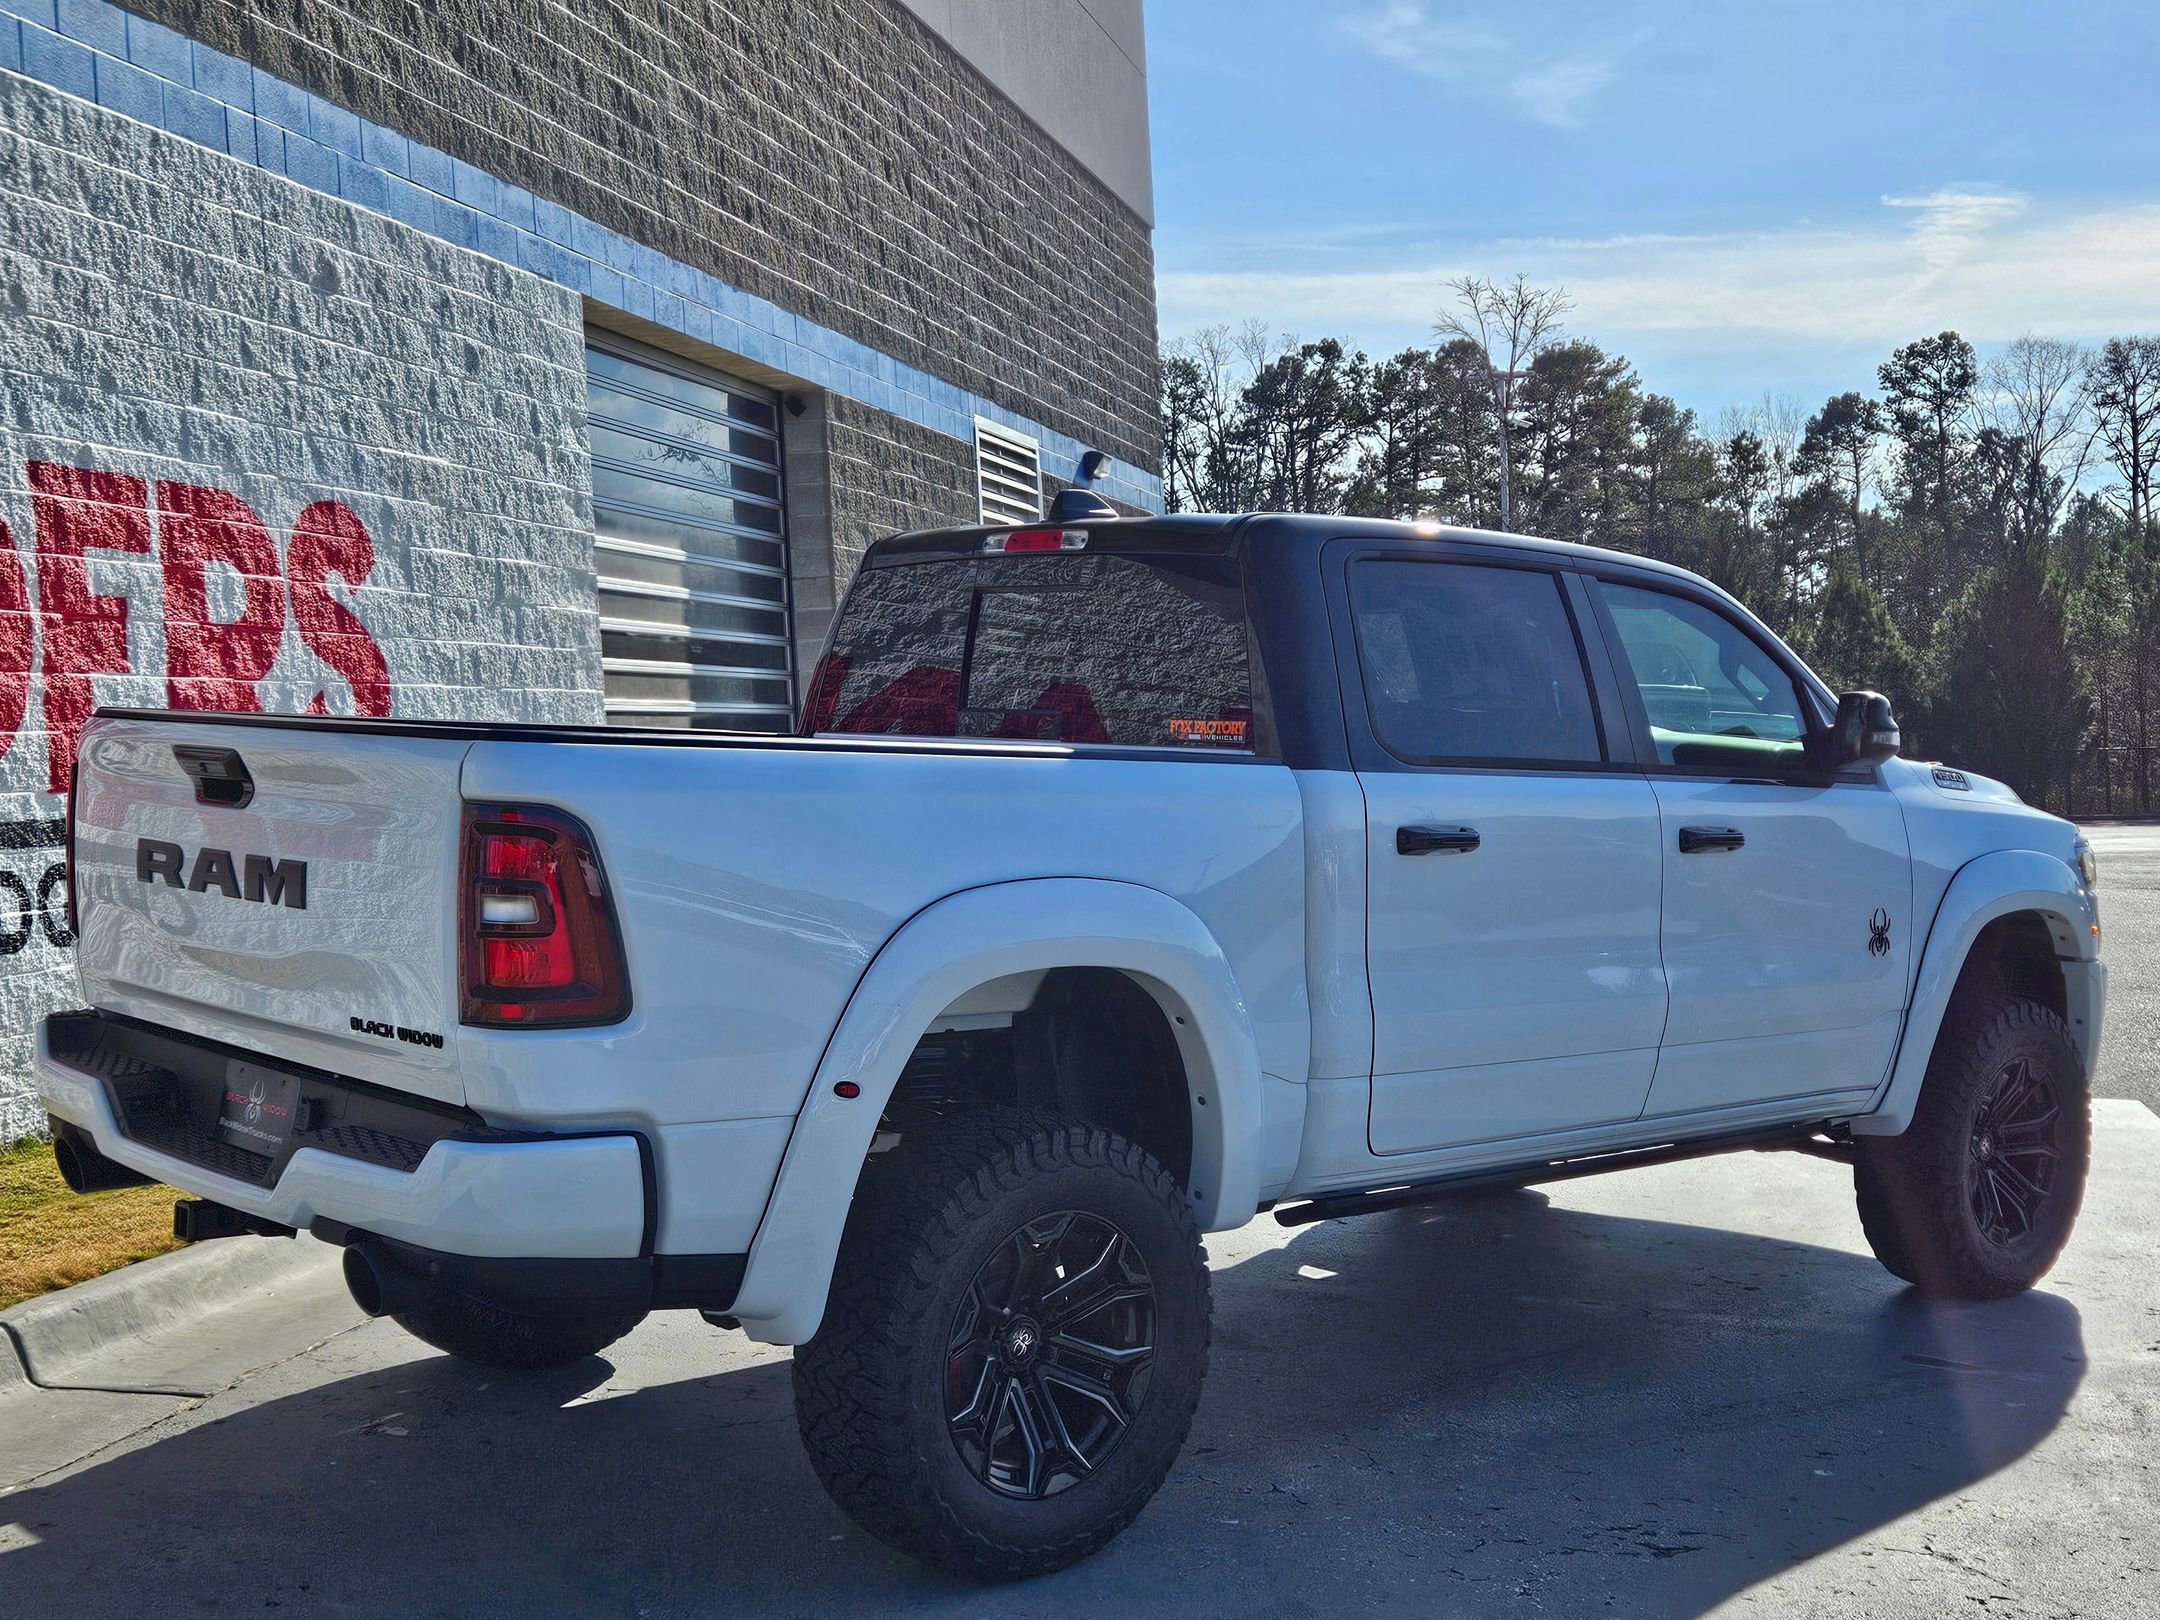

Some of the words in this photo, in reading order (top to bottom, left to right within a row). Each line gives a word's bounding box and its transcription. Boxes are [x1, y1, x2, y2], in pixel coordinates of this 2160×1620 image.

[1169, 719, 1193, 735] FOX
[1193, 720, 1247, 735] FACTORY
[1938, 770, 1964, 782] 1500
[137, 838, 307, 910] RAM
[350, 1016, 395, 1039] BLACK
[397, 1026, 444, 1049] WIDOW
